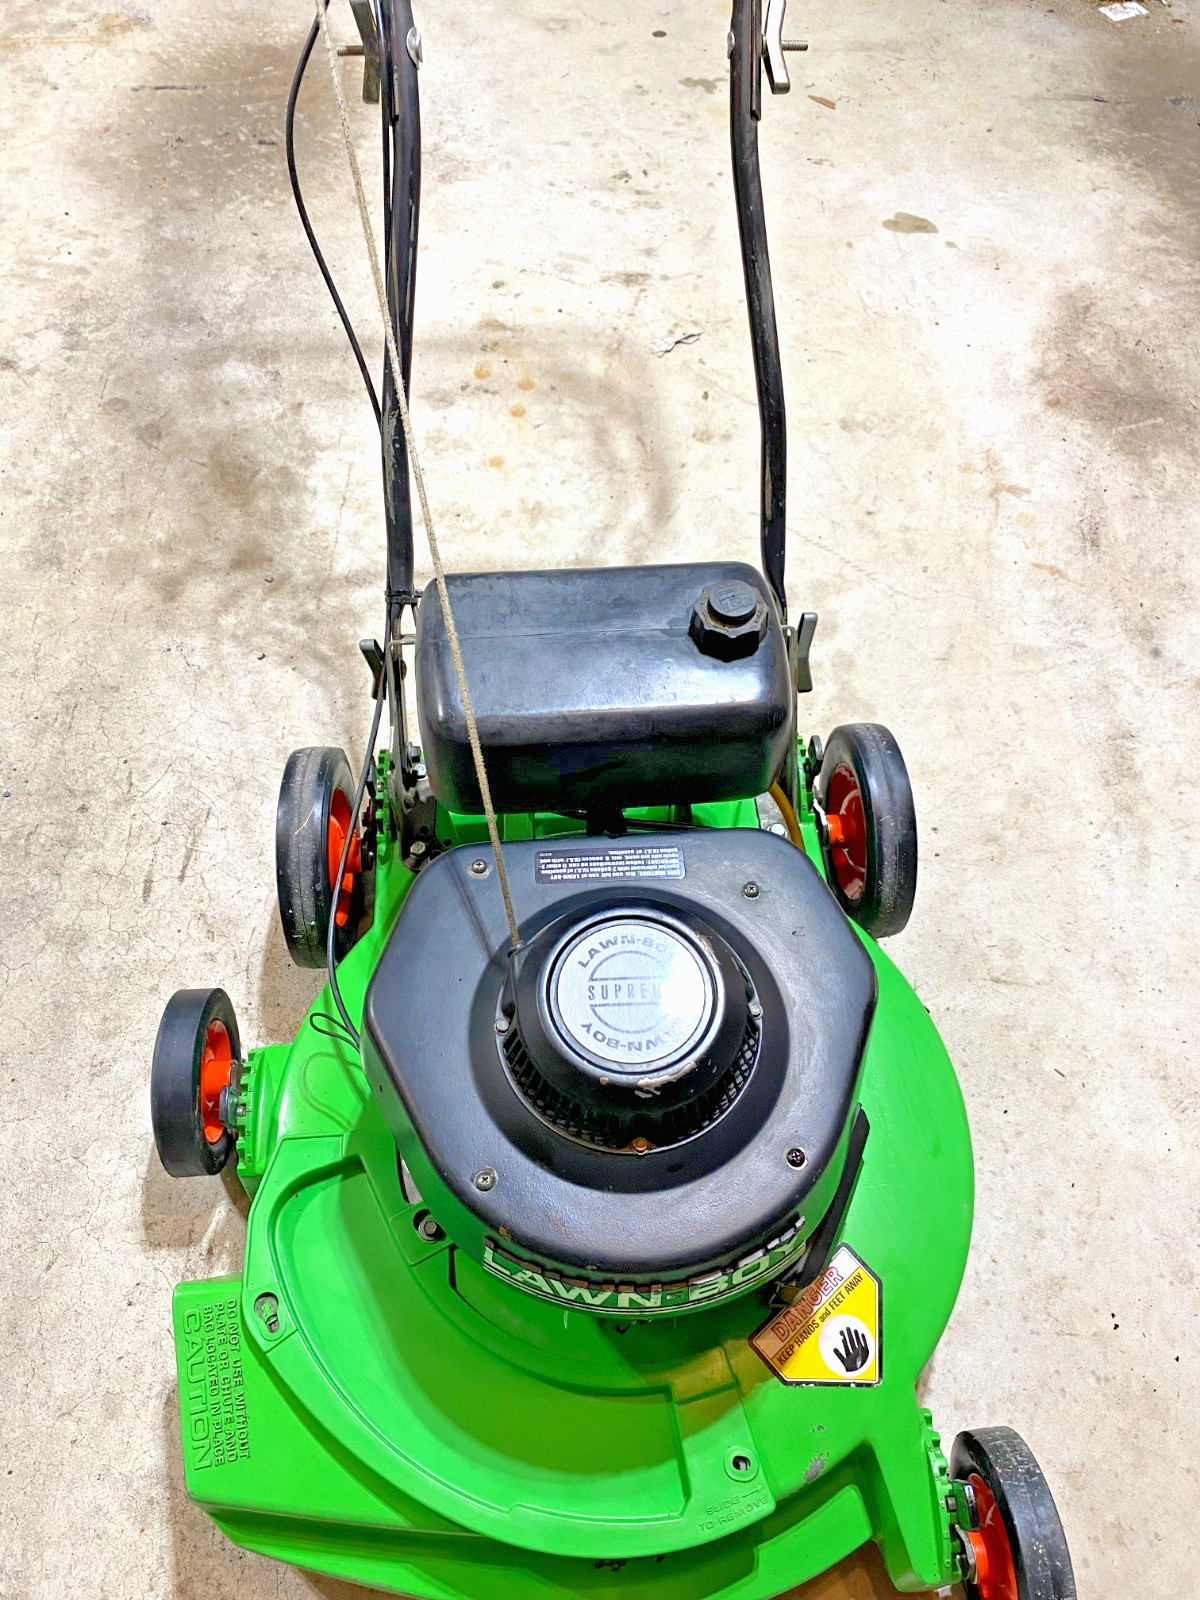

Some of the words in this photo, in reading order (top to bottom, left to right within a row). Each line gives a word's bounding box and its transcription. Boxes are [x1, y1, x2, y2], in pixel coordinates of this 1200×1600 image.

[578, 935, 668, 968] LAWN-BO
[588, 984, 664, 1001] SUPREM
[482, 1240, 807, 1307] LAWN-BOY
[203, 1305, 215, 1333] BAG
[227, 1298, 237, 1319] DO
[770, 1266, 844, 1343] DANGER
[776, 1344, 796, 1366] KEEP
[794, 1319, 821, 1347] HANDS
[818, 1307, 832, 1323] and
[829, 1292, 846, 1311] FEET
[844, 1271, 864, 1295] AWAY
[215, 1302, 227, 1346] PLATE
[228, 1322, 240, 1352] NOT
[205, 1335, 220, 1397] LOCATED
[219, 1349, 229, 1371] OR
[232, 1358, 243, 1388] USE
[183, 1308, 213, 1471] CAUTION
[221, 1375, 235, 1425] CHUTE
[210, 1400, 222, 1417] IN
[235, 1391, 251, 1460] WITHOUT
[212, 1420, 226, 1467] PLACE
[225, 1430, 238, 1462] AND
[699, 1520, 715, 1532] TO
[719, 1495, 769, 1525] REMOVE
[706, 1495, 740, 1515] SLIDE
